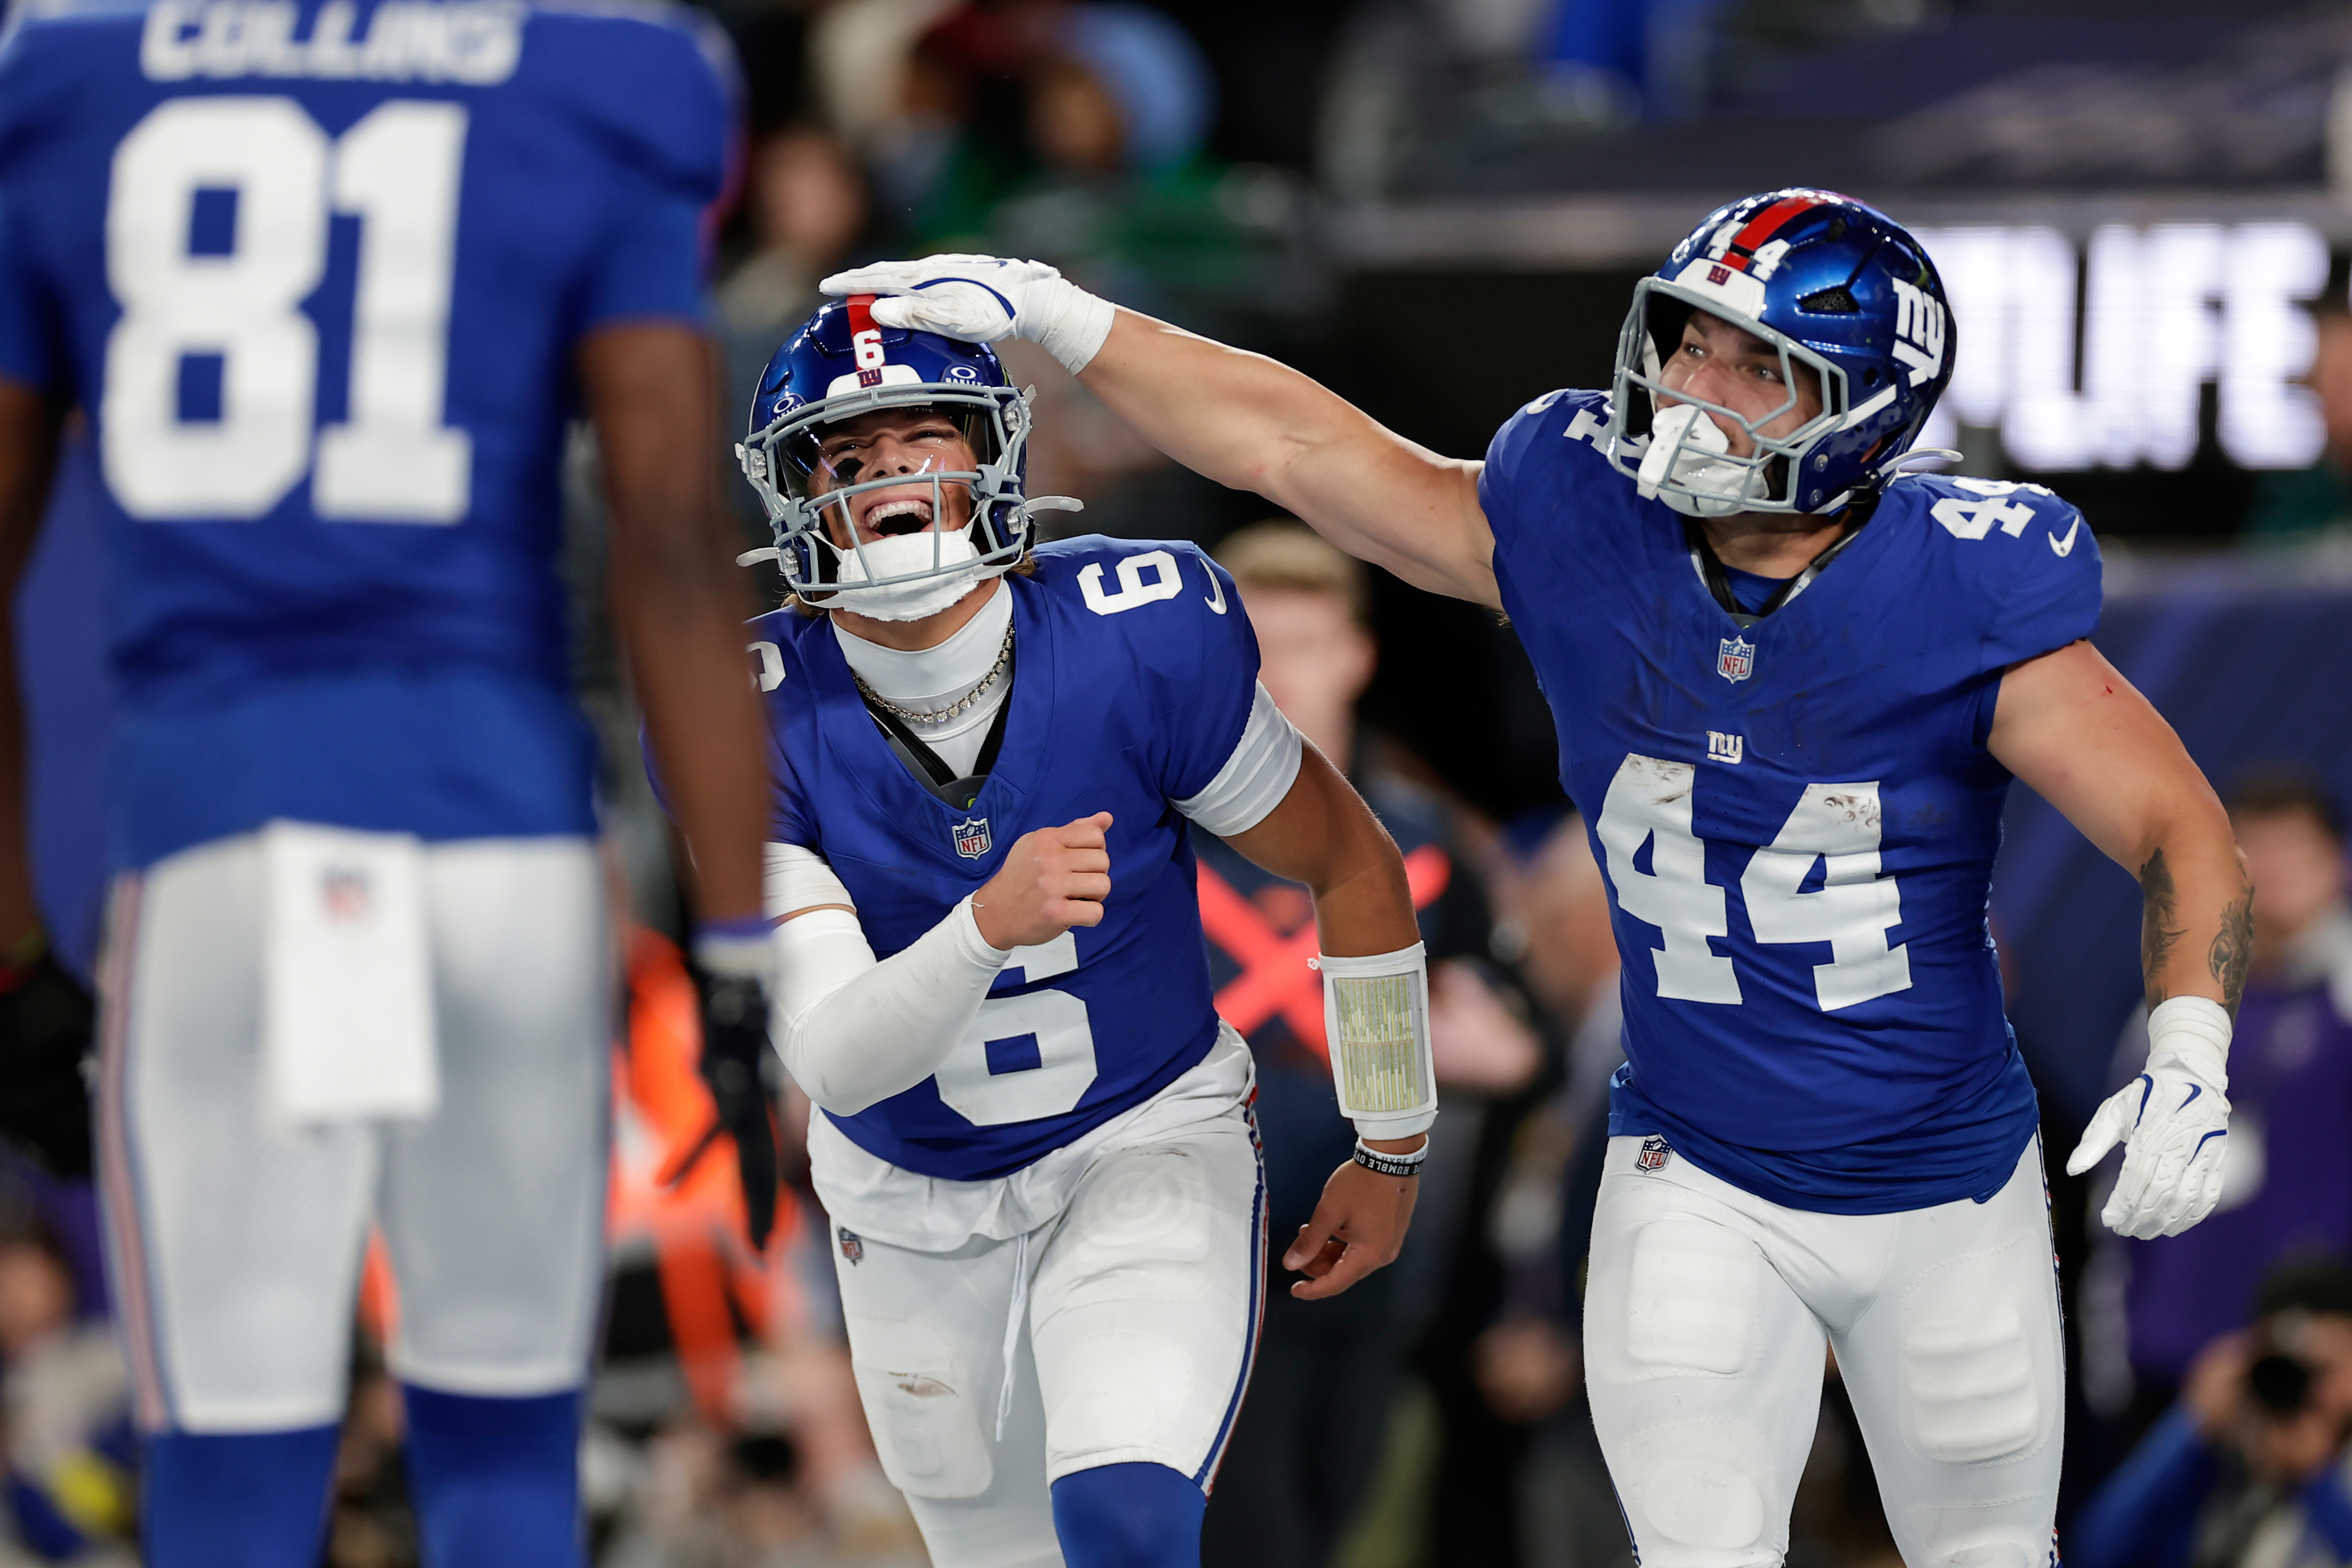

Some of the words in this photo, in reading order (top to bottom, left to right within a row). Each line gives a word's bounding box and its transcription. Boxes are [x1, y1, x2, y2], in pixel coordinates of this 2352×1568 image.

[99, 94, 475, 526] 81
[853, 328, 885, 370] 6
[1723, 656, 1747, 675] NFL
[960, 836, 986, 852] NFL
[1595, 752, 1913, 1012] 44
[934, 930, 1098, 1127] 6
[1368, 1158, 1410, 1175] HUMBLE
[1640, 1151, 1664, 1167] NFL
